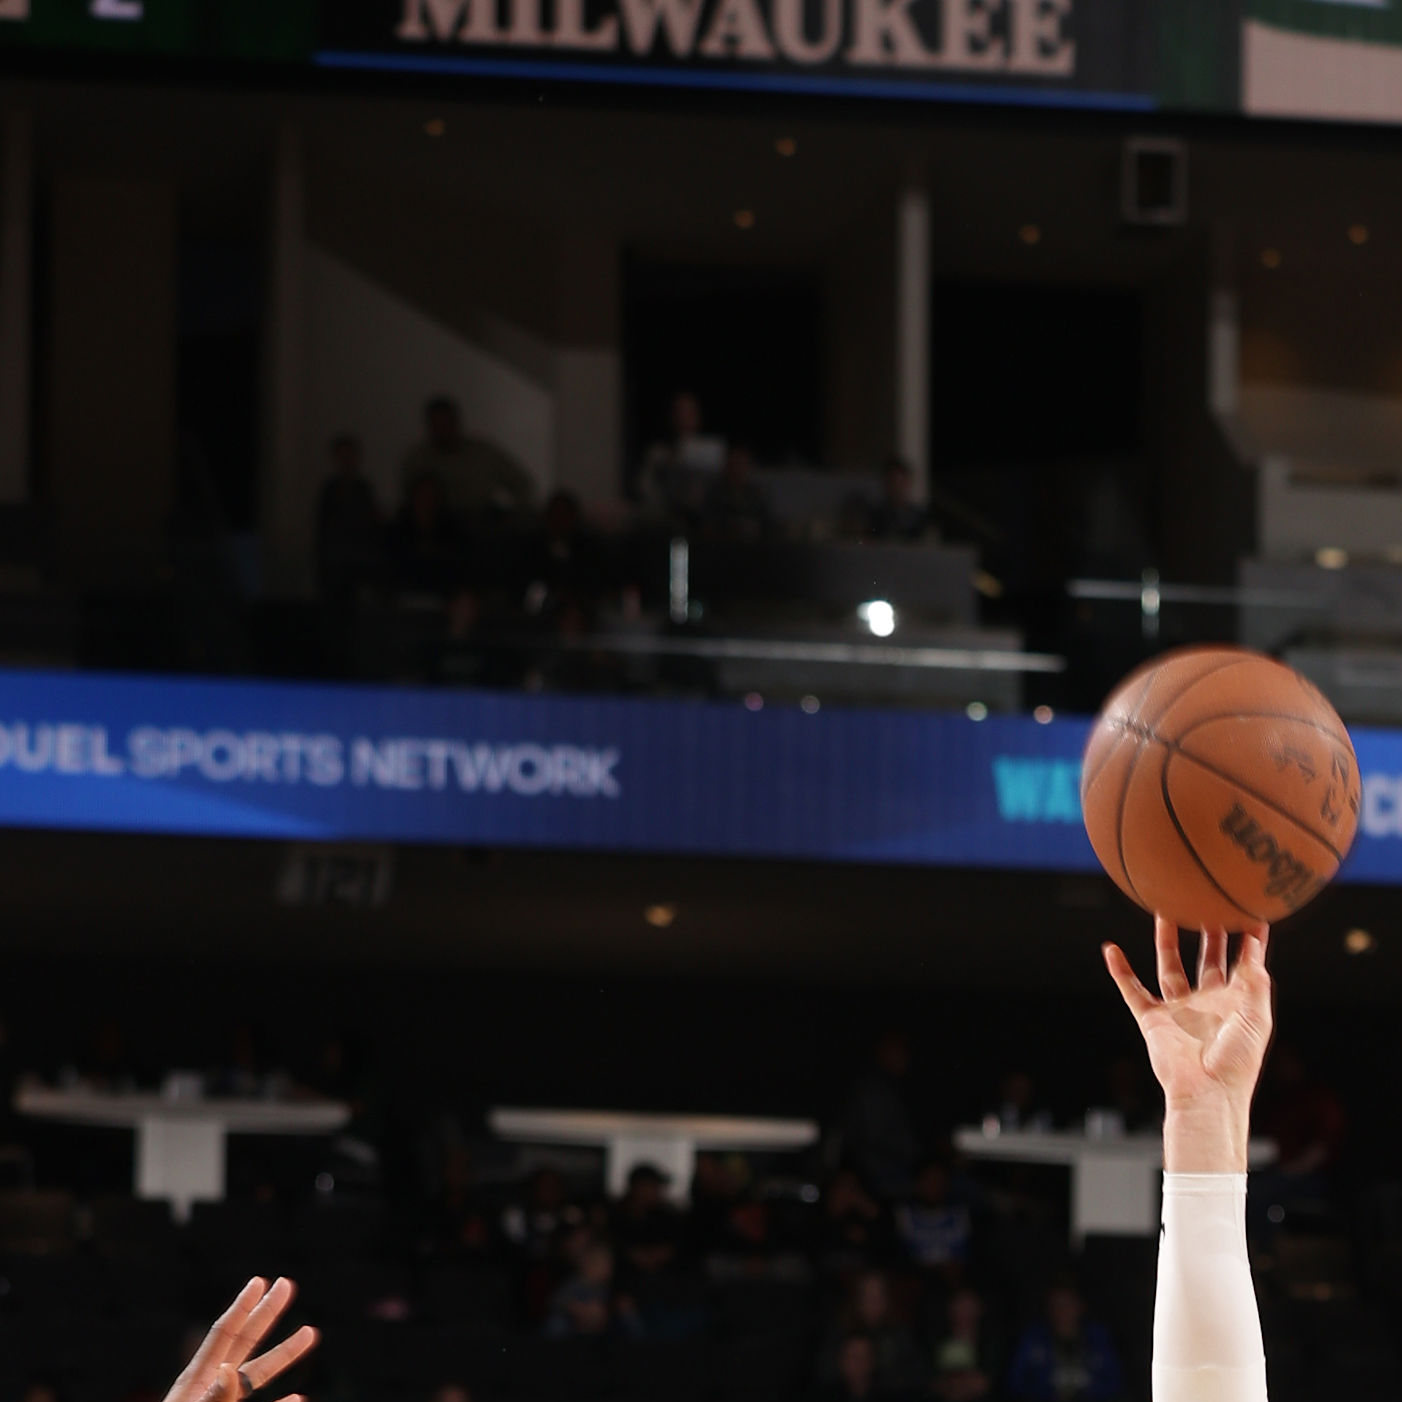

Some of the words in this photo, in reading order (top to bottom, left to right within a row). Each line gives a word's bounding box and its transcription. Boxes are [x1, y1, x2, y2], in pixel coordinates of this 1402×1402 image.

[0, 721, 124, 775] UEL
[128, 728, 344, 787] SPORTS
[350, 737, 621, 798] NETWORK
